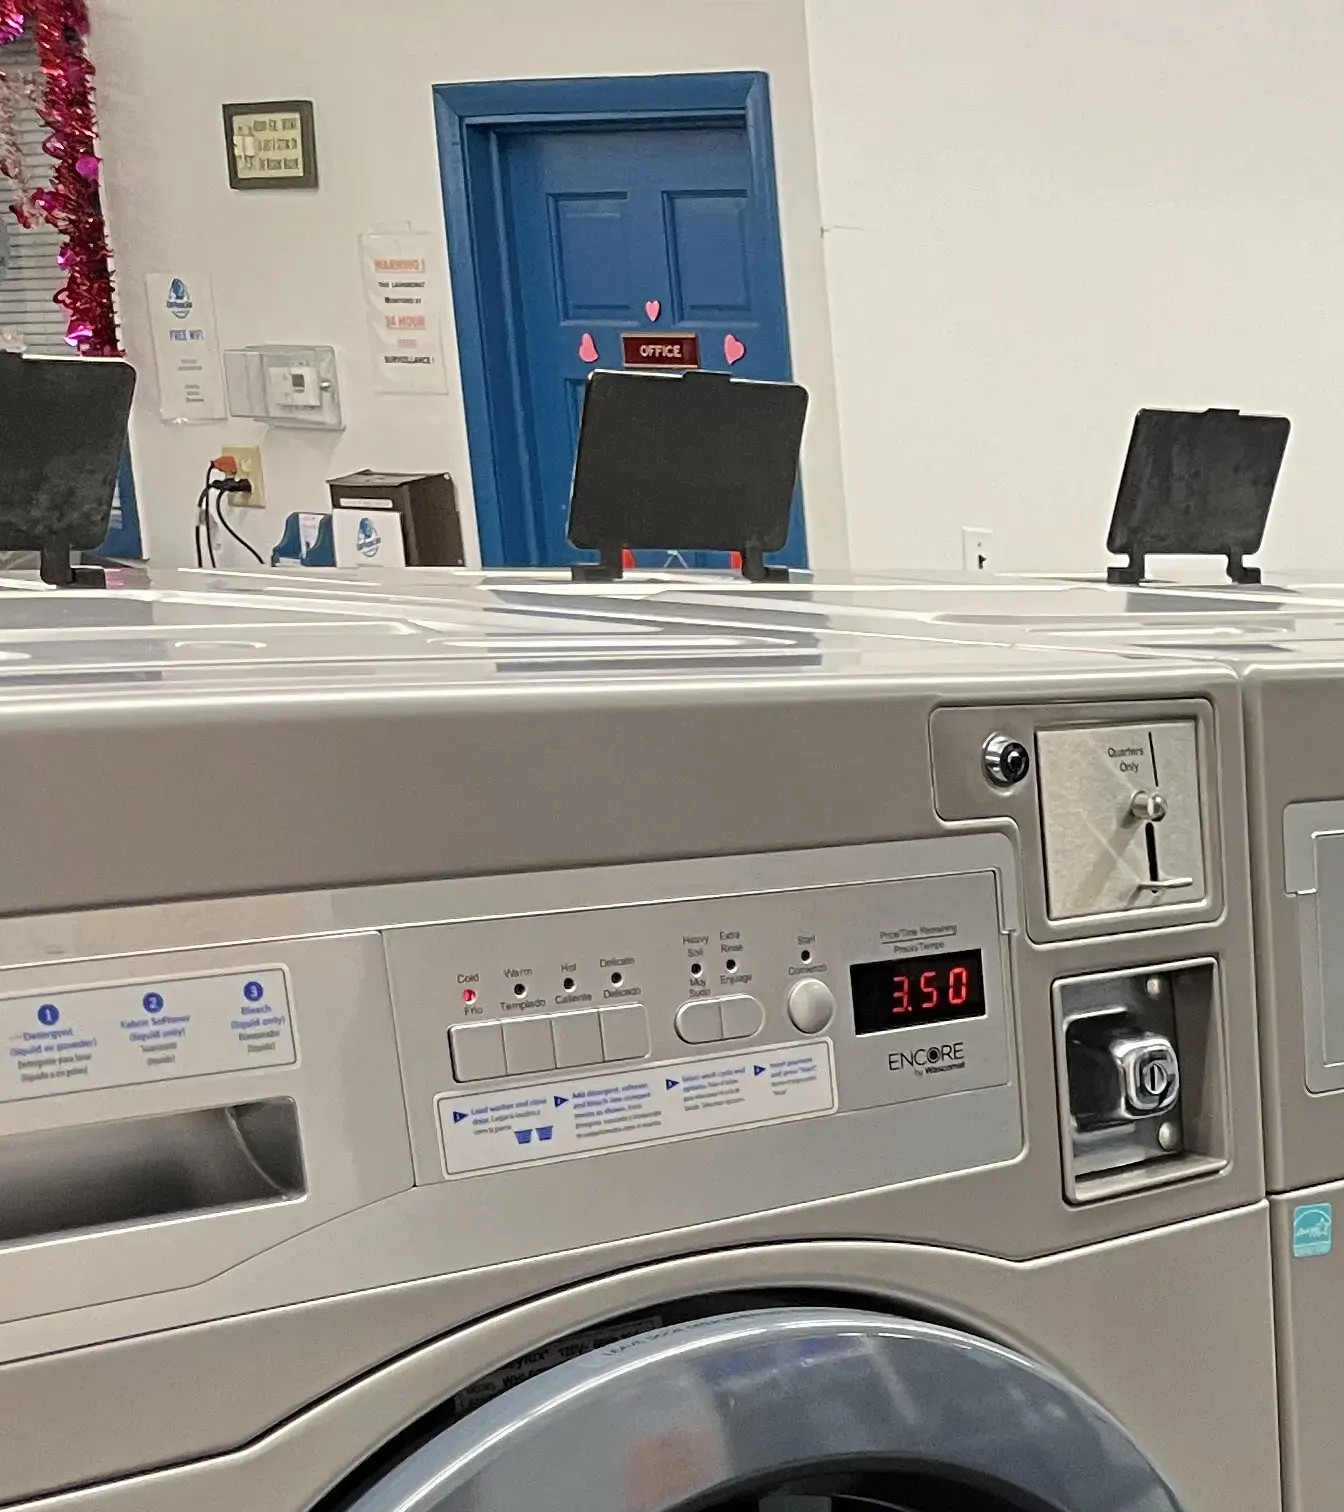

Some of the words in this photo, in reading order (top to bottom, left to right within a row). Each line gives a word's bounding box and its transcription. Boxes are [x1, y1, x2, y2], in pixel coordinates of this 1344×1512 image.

[640, 345, 682, 358] OFFICE
[1119, 761, 1140, 773] Only
[457, 973, 480, 985] Cold
[503, 968, 533, 978] Warm
[892, 967, 968, 1013] 3.50
[888, 1042, 965, 1071] ENCORE
